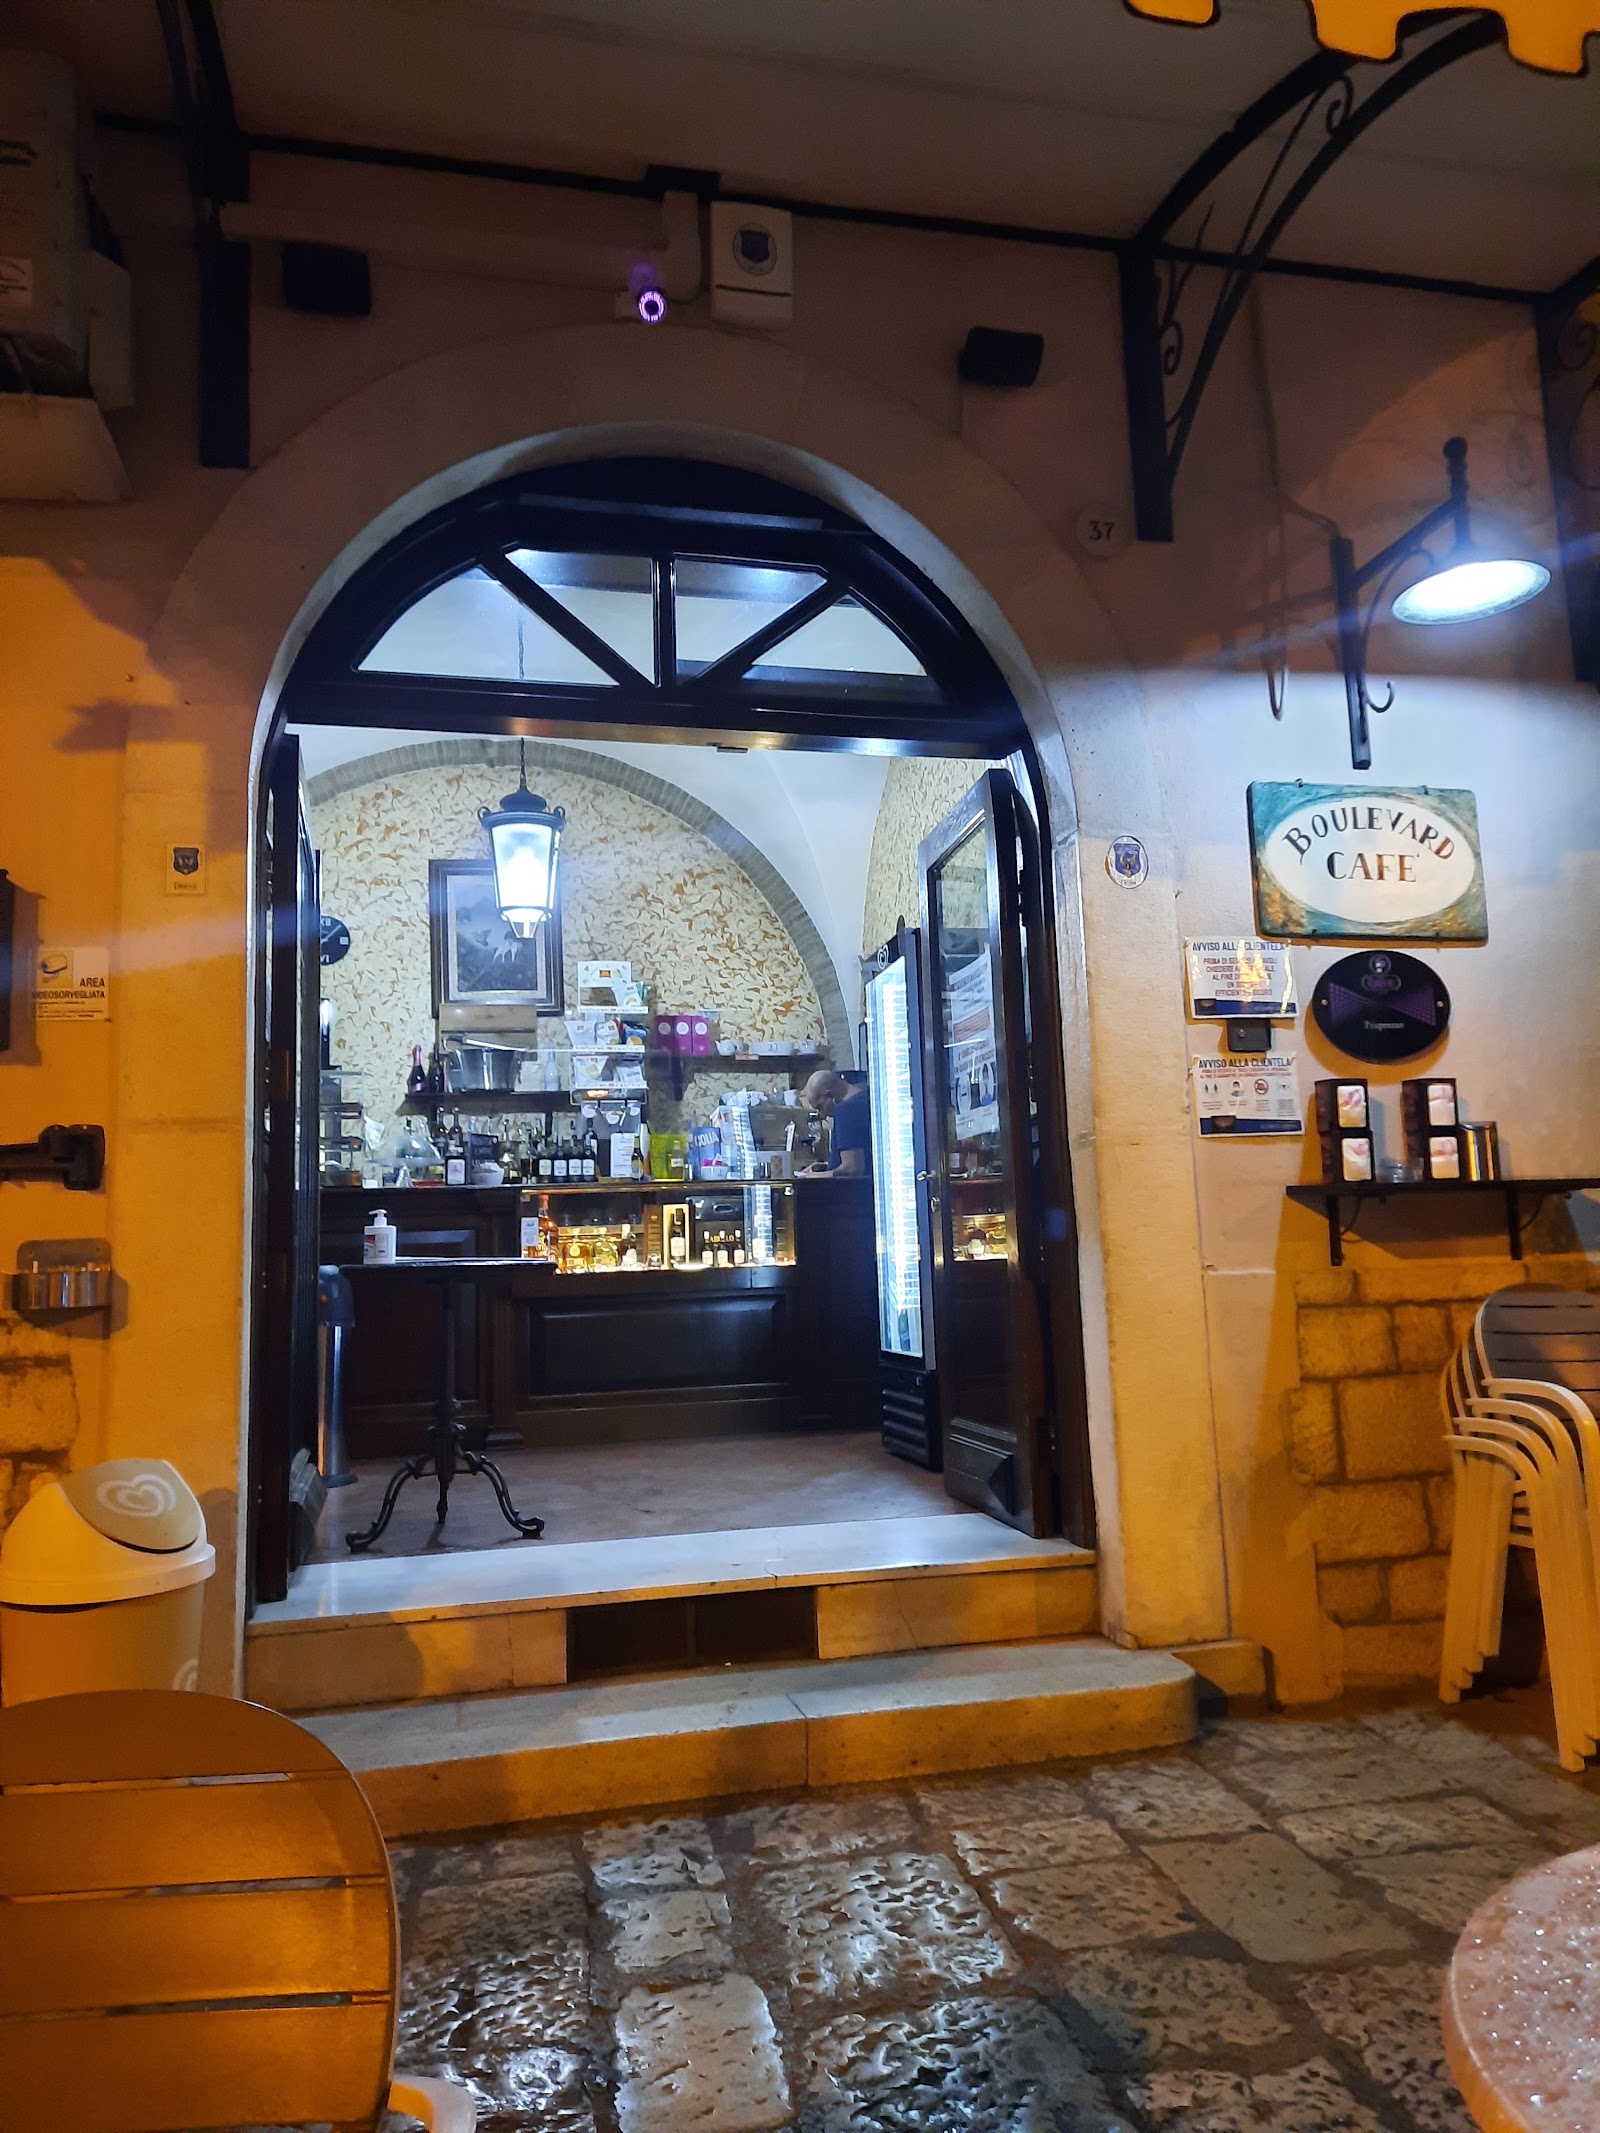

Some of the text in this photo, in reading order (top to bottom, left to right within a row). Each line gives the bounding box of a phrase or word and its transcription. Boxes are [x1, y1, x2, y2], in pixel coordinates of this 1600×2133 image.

[1089, 520, 1115, 540] 37
[1281, 806, 1455, 865] BOULEVARD
[1192, 942, 1220, 951] AVVISO
[79, 977, 105, 988] AREA
[32, 991, 105, 999] VIDEOSORVEGLIATA
[1198, 1057, 1291, 1068] AVVISO ALLA CLIENTELA
